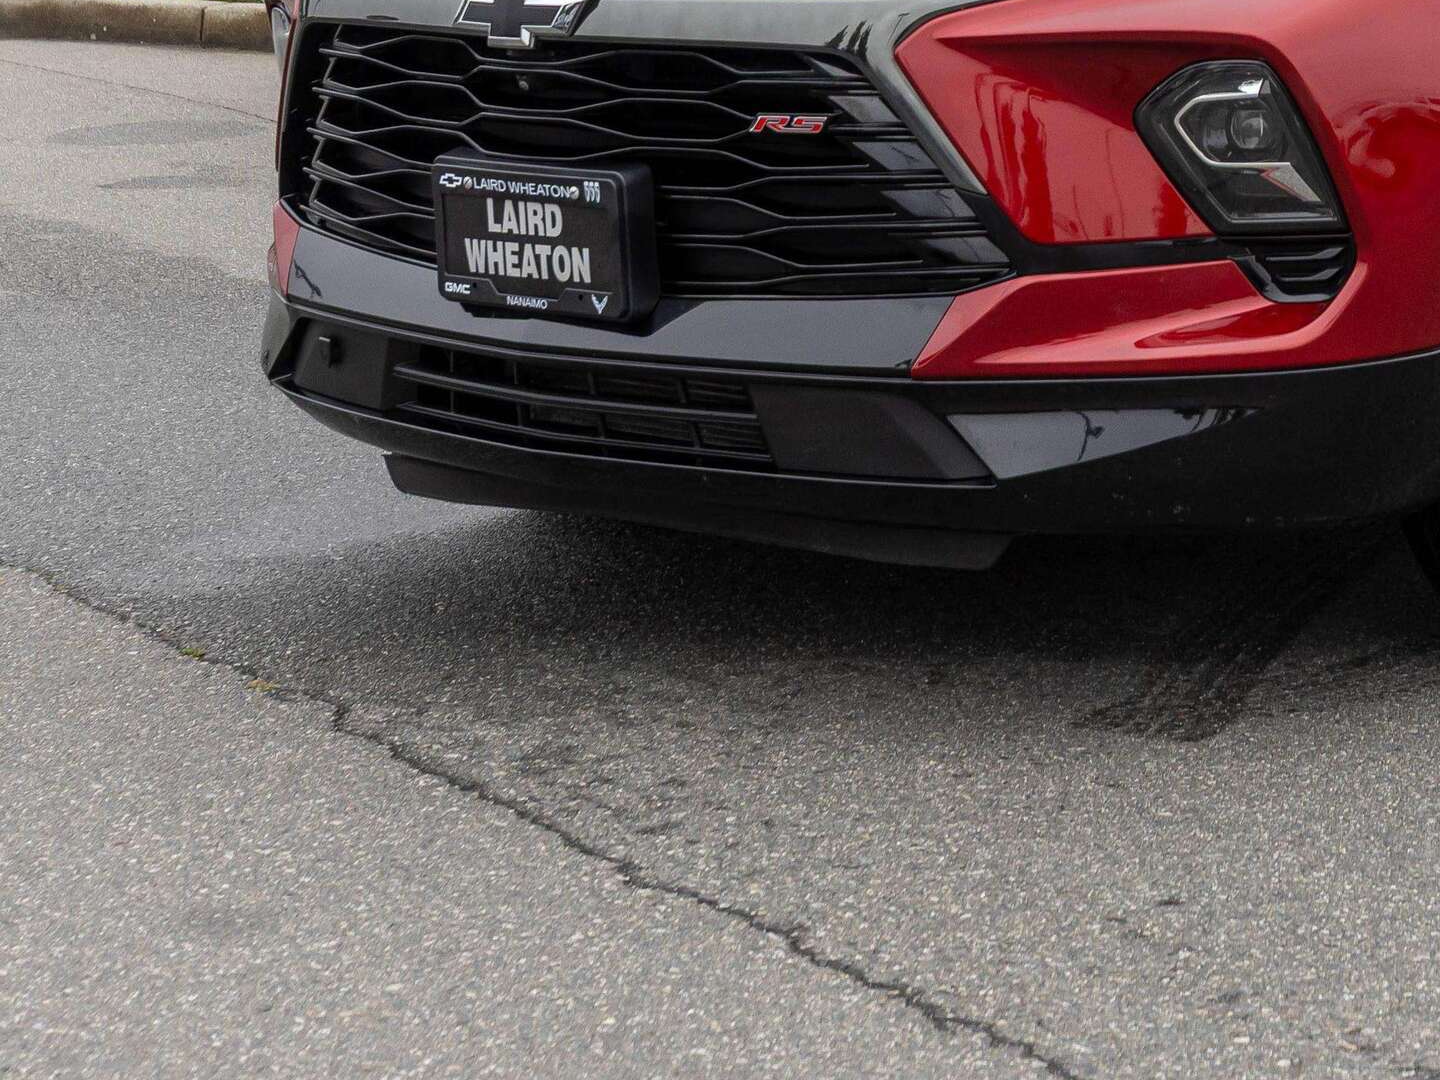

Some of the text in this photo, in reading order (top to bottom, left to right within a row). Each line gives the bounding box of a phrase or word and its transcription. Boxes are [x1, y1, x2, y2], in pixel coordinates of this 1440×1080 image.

[749, 114, 829, 134] RS
[473, 176, 571, 199] LAIRD WHEATON
[485, 197, 563, 238] LAIRD
[464, 237, 592, 284] WHEATON
[444, 281, 471, 295] GMC
[506, 295, 548, 310] NANAIMO
